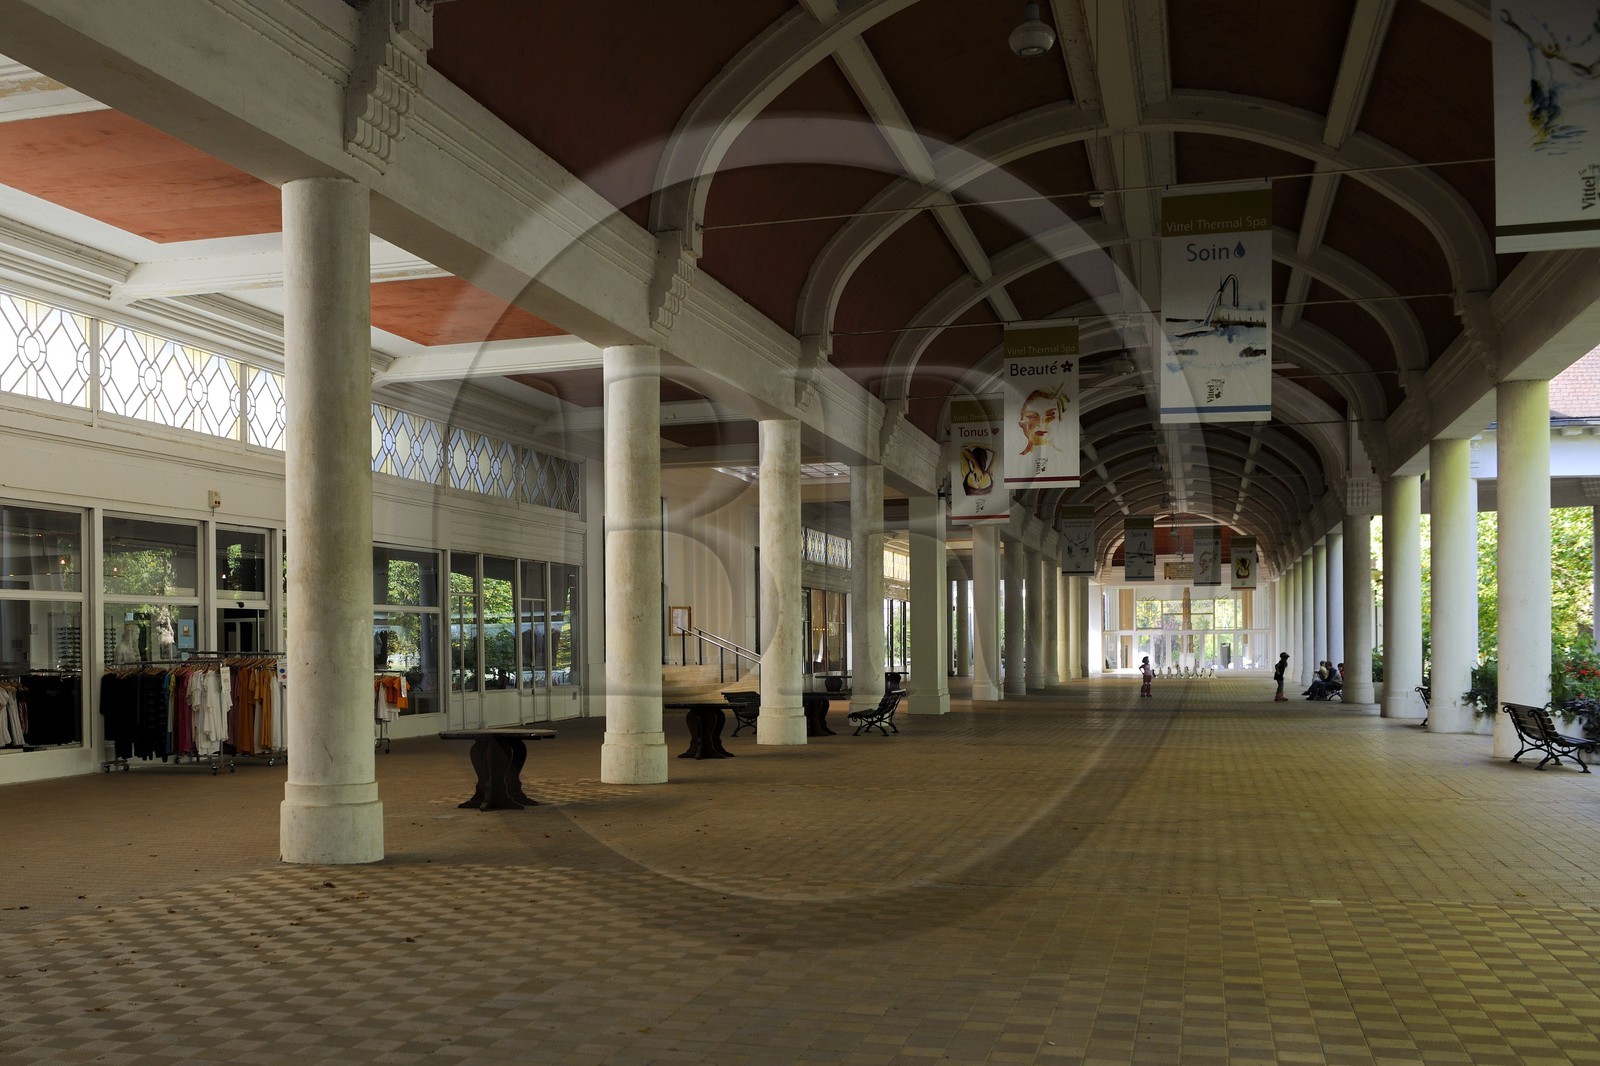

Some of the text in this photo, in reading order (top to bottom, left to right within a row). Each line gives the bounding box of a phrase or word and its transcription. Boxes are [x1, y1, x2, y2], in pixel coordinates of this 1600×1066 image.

[1582, 177, 1595, 210] Vittel
[1166, 216, 1267, 232] Vittel Thermal Spa
[1186, 243, 1230, 262] Soin
[1006, 344, 1076, 355] Vittel Thermal Spa
[1010, 360, 1058, 377] Beauté
[958, 427, 989, 438] Tonus
